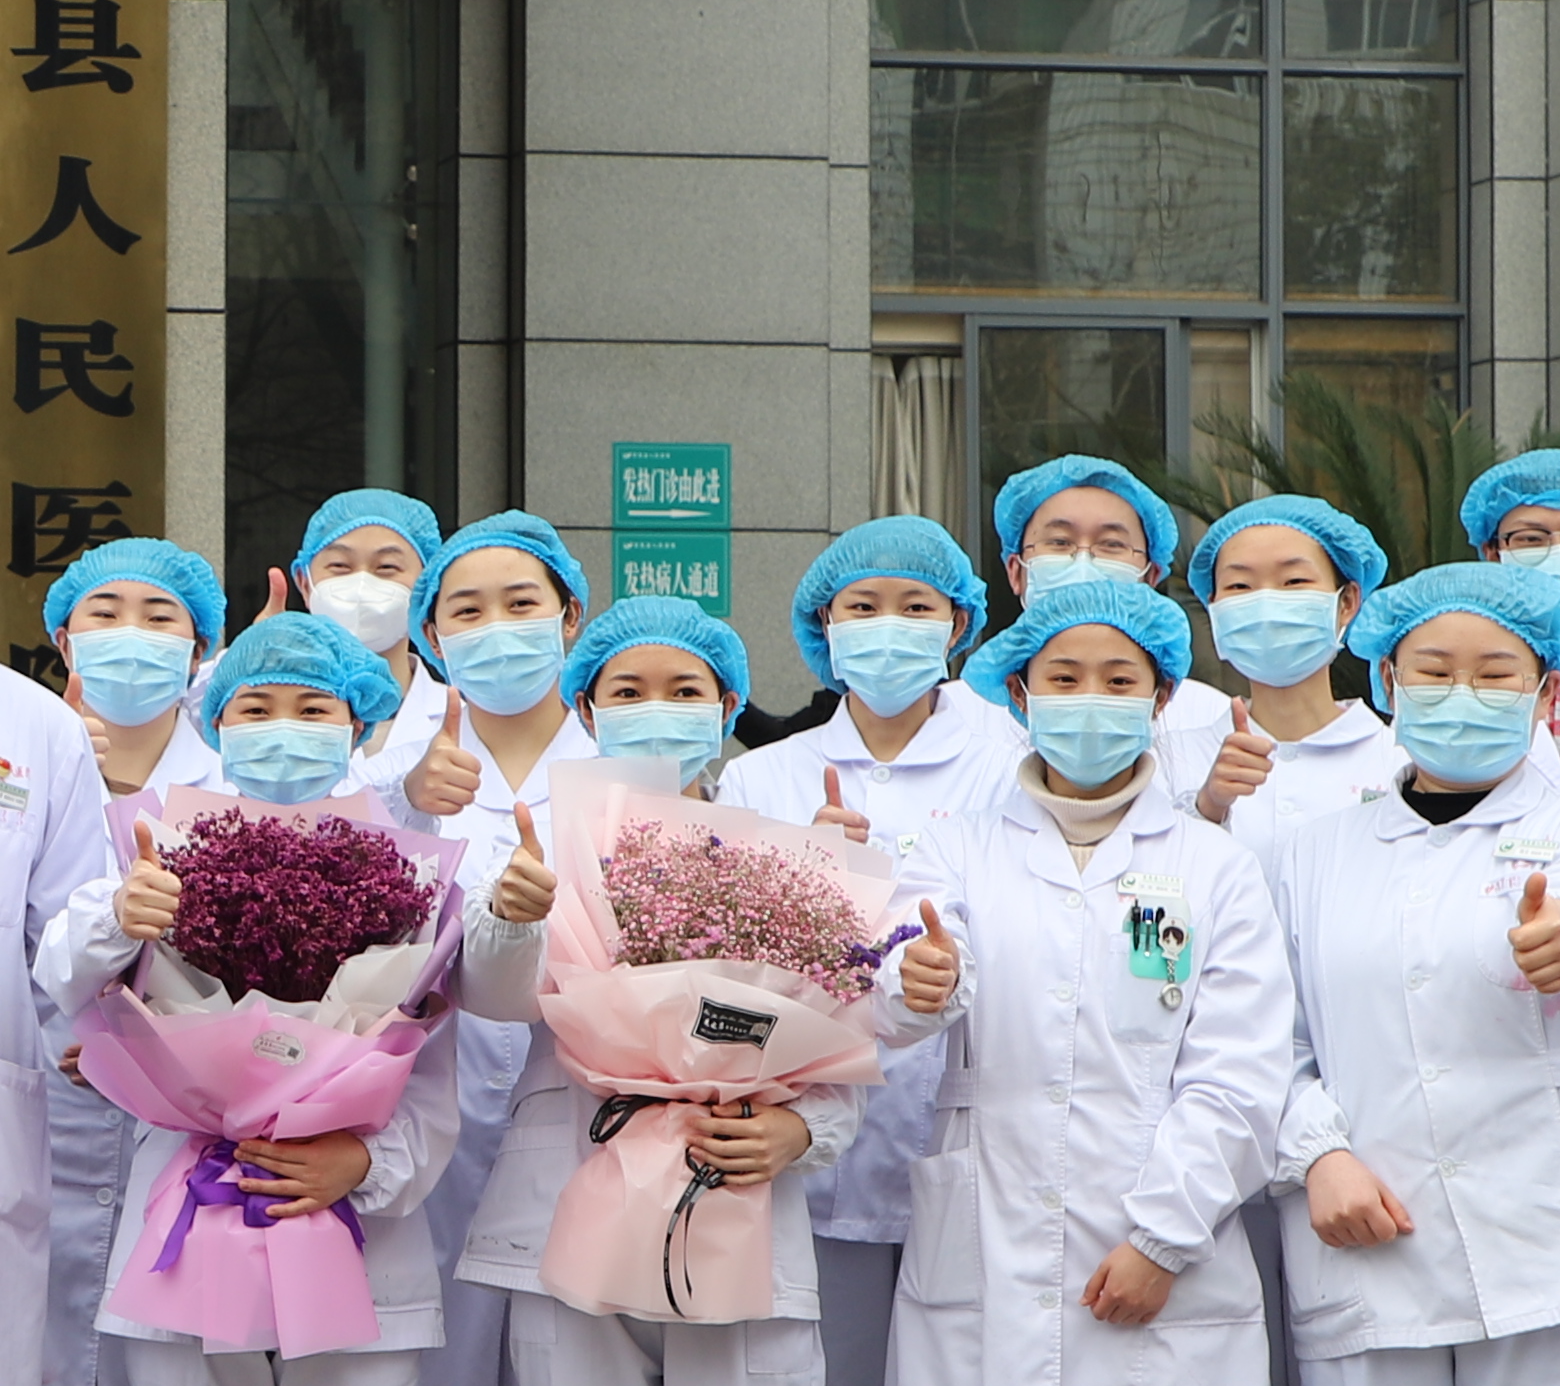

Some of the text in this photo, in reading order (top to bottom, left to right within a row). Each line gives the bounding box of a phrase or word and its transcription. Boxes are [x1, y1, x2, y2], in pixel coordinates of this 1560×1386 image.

[623, 467, 720, 504] 发热门诊由此进
[624, 561, 719, 597] 发热病人通道
